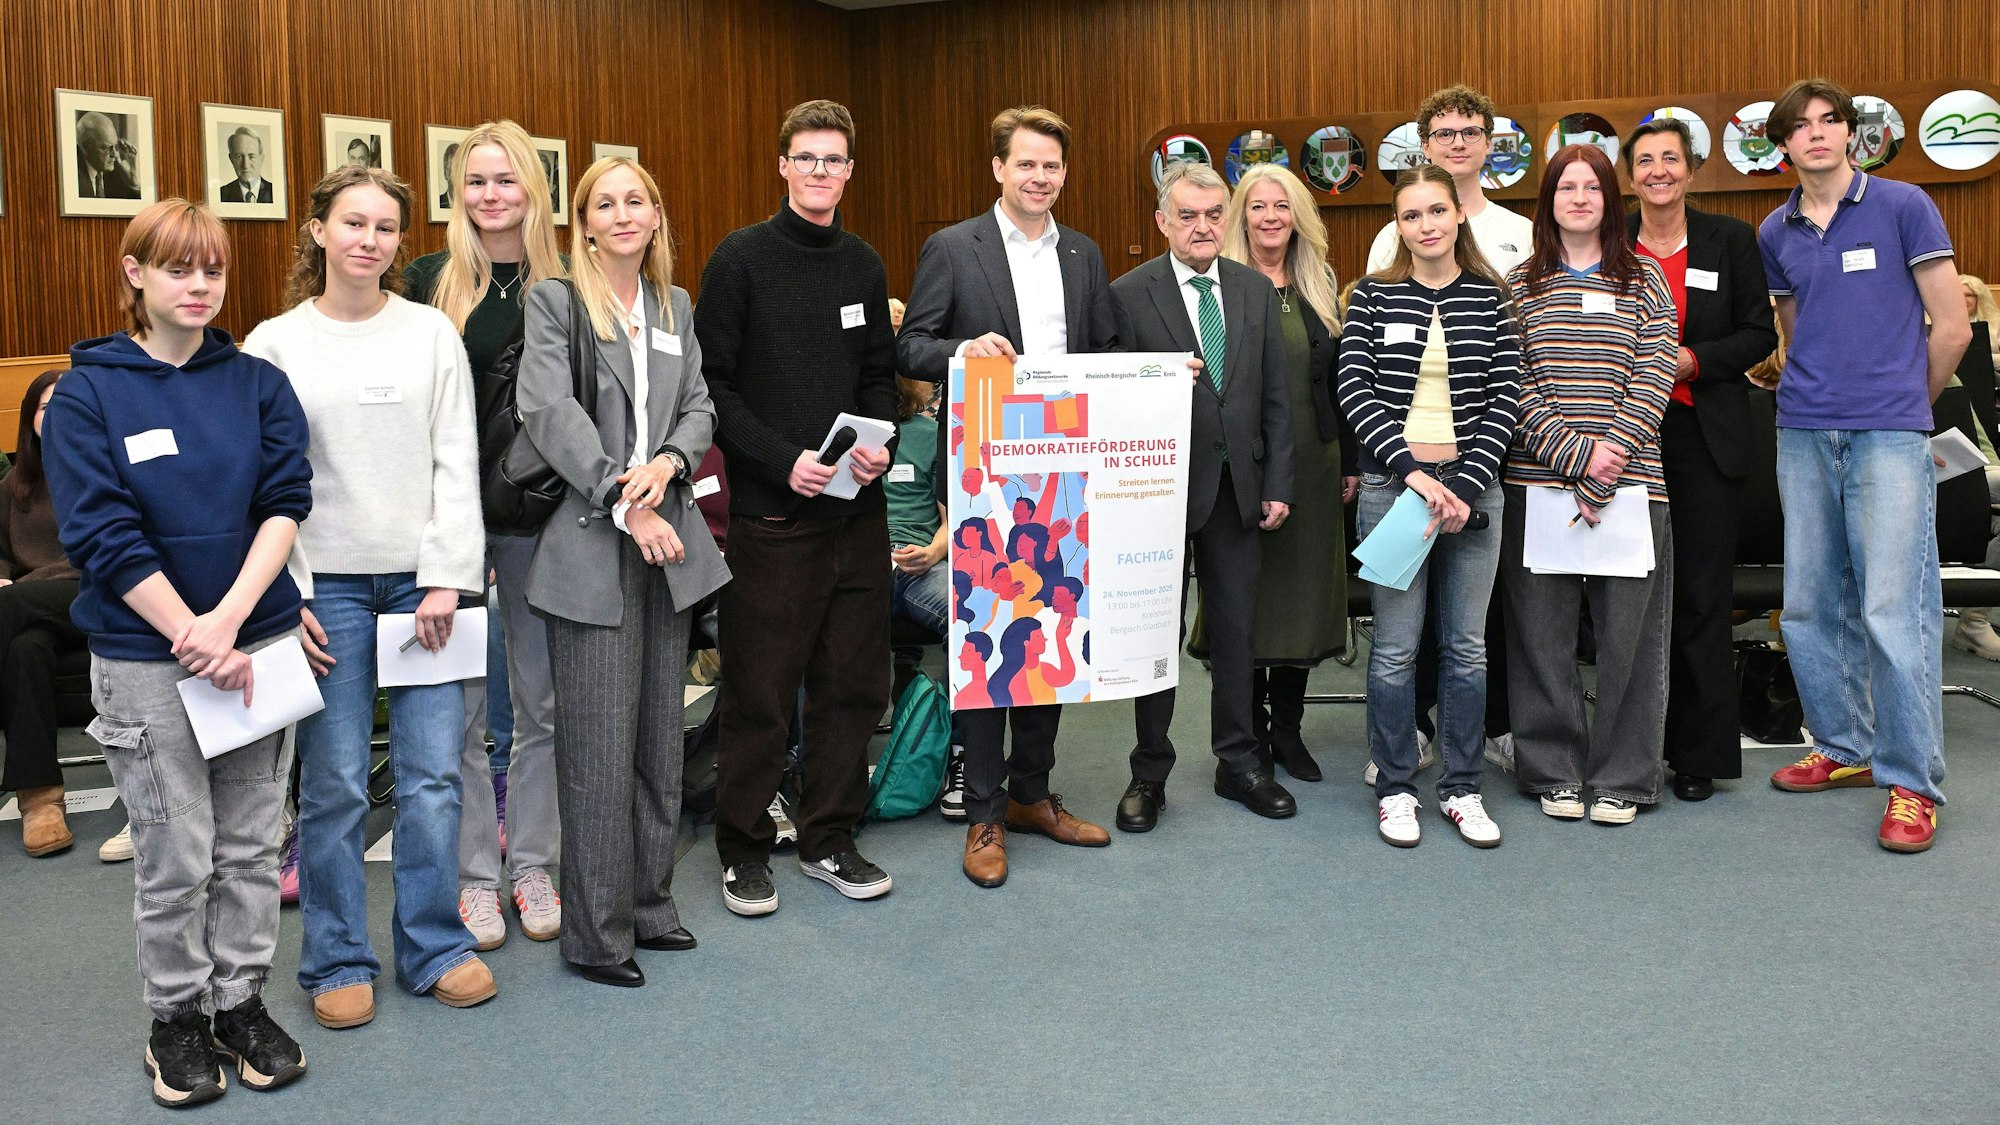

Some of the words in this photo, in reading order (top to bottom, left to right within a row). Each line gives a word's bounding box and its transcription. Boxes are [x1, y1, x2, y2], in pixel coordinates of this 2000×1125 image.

[1085, 372, 1138, 380] Rheinisch-Bergischer
[991, 438, 1177, 457] DEMOKRATIEFÖRDERUNG
[1104, 457, 1120, 469] IN
[1124, 454, 1177, 468] SCHULE
[1118, 479, 1149, 487] Streiten
[1151, 477, 1176, 486] lernen.
[1095, 490, 1139, 501] Erinnerung
[1140, 489, 1176, 499] gestalten.
[1117, 549, 1174, 565] FACHTAG
[1103, 591, 1115, 599] 24.
[1117, 588, 1157, 598] November
[1158, 584, 1173, 593] 2025
[1107, 601, 1128, 611] 13:00
[1130, 600, 1141, 609] bis
[1110, 624, 1142, 635] Bergisch
